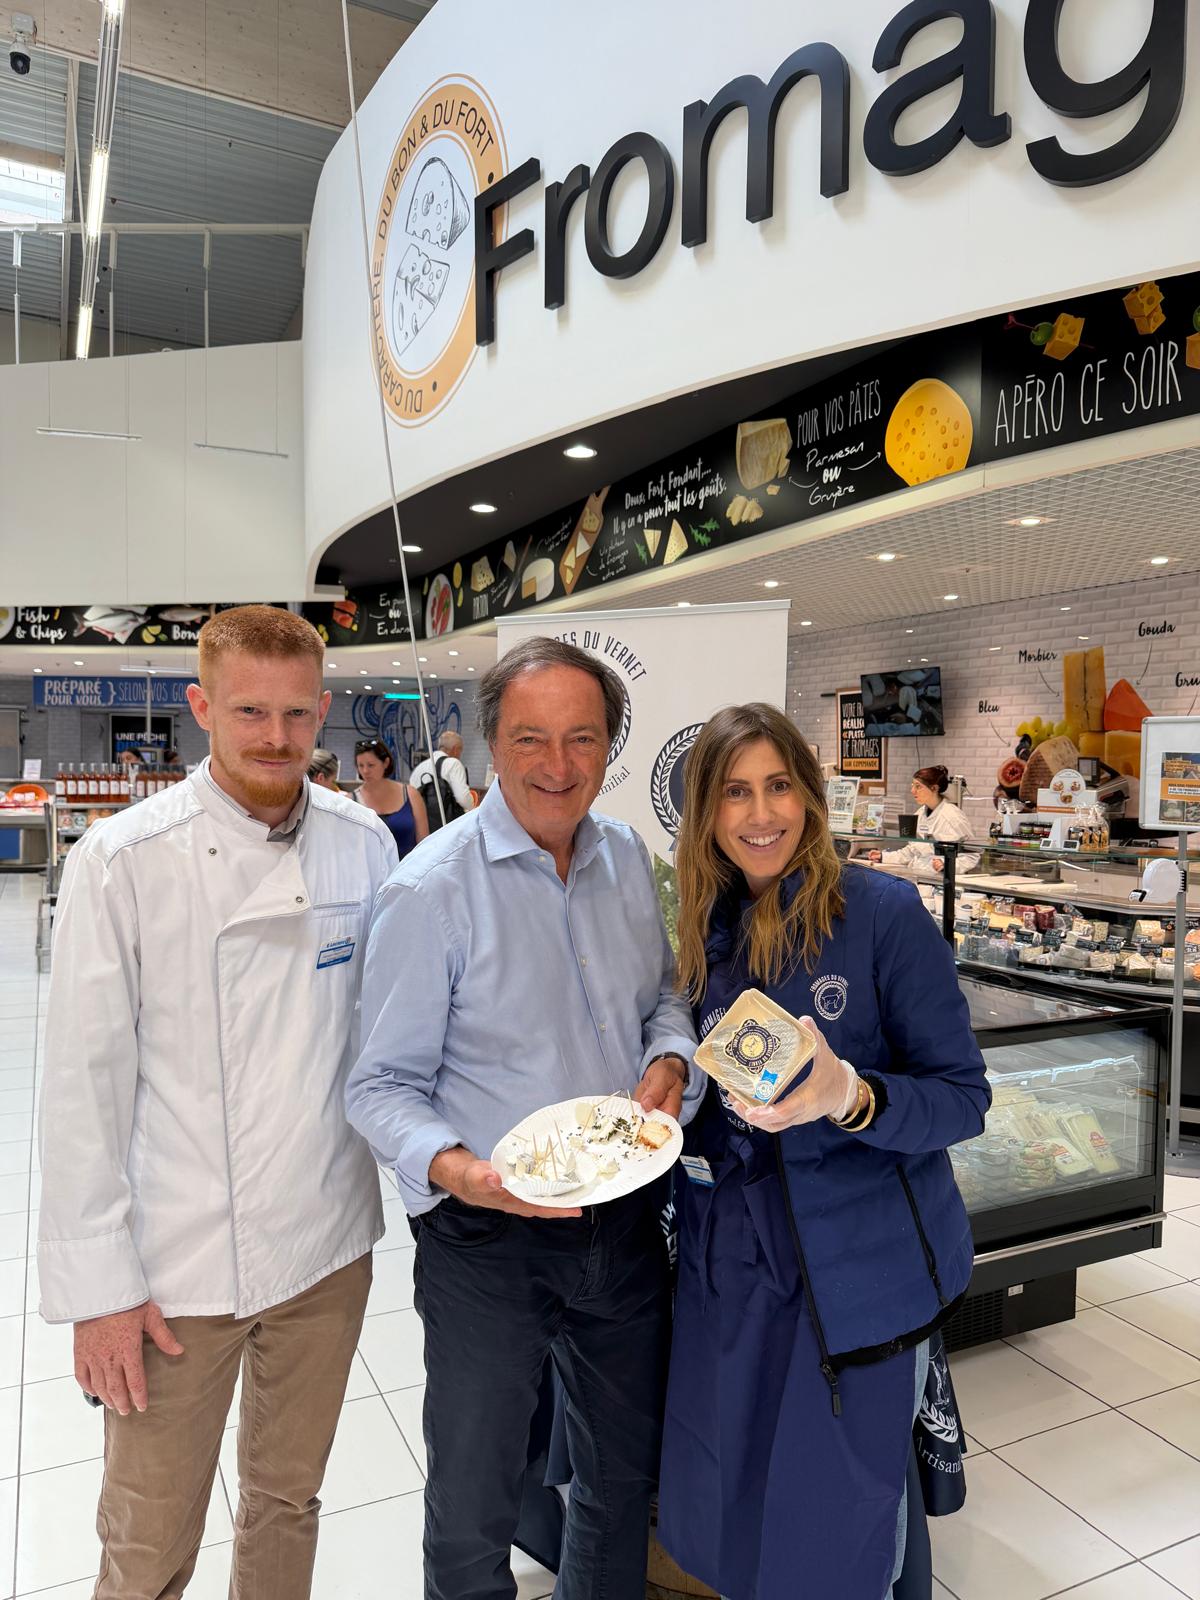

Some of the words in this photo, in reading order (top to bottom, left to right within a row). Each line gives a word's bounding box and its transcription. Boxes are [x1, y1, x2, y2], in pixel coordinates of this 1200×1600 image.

[420, 114, 429, 139] &
[432, 99, 455, 128] DU
[456, 101, 494, 157] FORT
[391, 129, 417, 191] BON
[474, 0, 1189, 346] Fromag
[379, 196, 392, 240] DU
[1080, 359, 1107, 424] CE
[1122, 340, 1182, 415] SOIR
[404, 388, 423, 413] DU
[797, 408, 820, 449] POUR
[825, 395, 844, 437] VOS
[848, 379, 881, 428] PÂTES
[806, 441, 864, 472] Parmesan
[644, 505, 665, 528] pour
[664, 490, 682, 517] tout
[683, 487, 698, 507] les
[808, 485, 856, 509] Gruyère
[17, 607, 50, 624] Fish
[1138, 621, 1176, 637] Gouda
[15, 628, 27, 639] &
[30, 624, 67, 645] Chips
[584, 630, 600, 649] DU
[604, 635, 647, 681] VERNET
[1018, 649, 1058, 664] Morbier
[44, 677, 102, 695] PRÉPARÉ
[44, 695, 73, 706] POUR
[978, 700, 1000, 714] Bleu
[115, 732, 135, 741] UNE
[597, 766, 630, 796] milial
